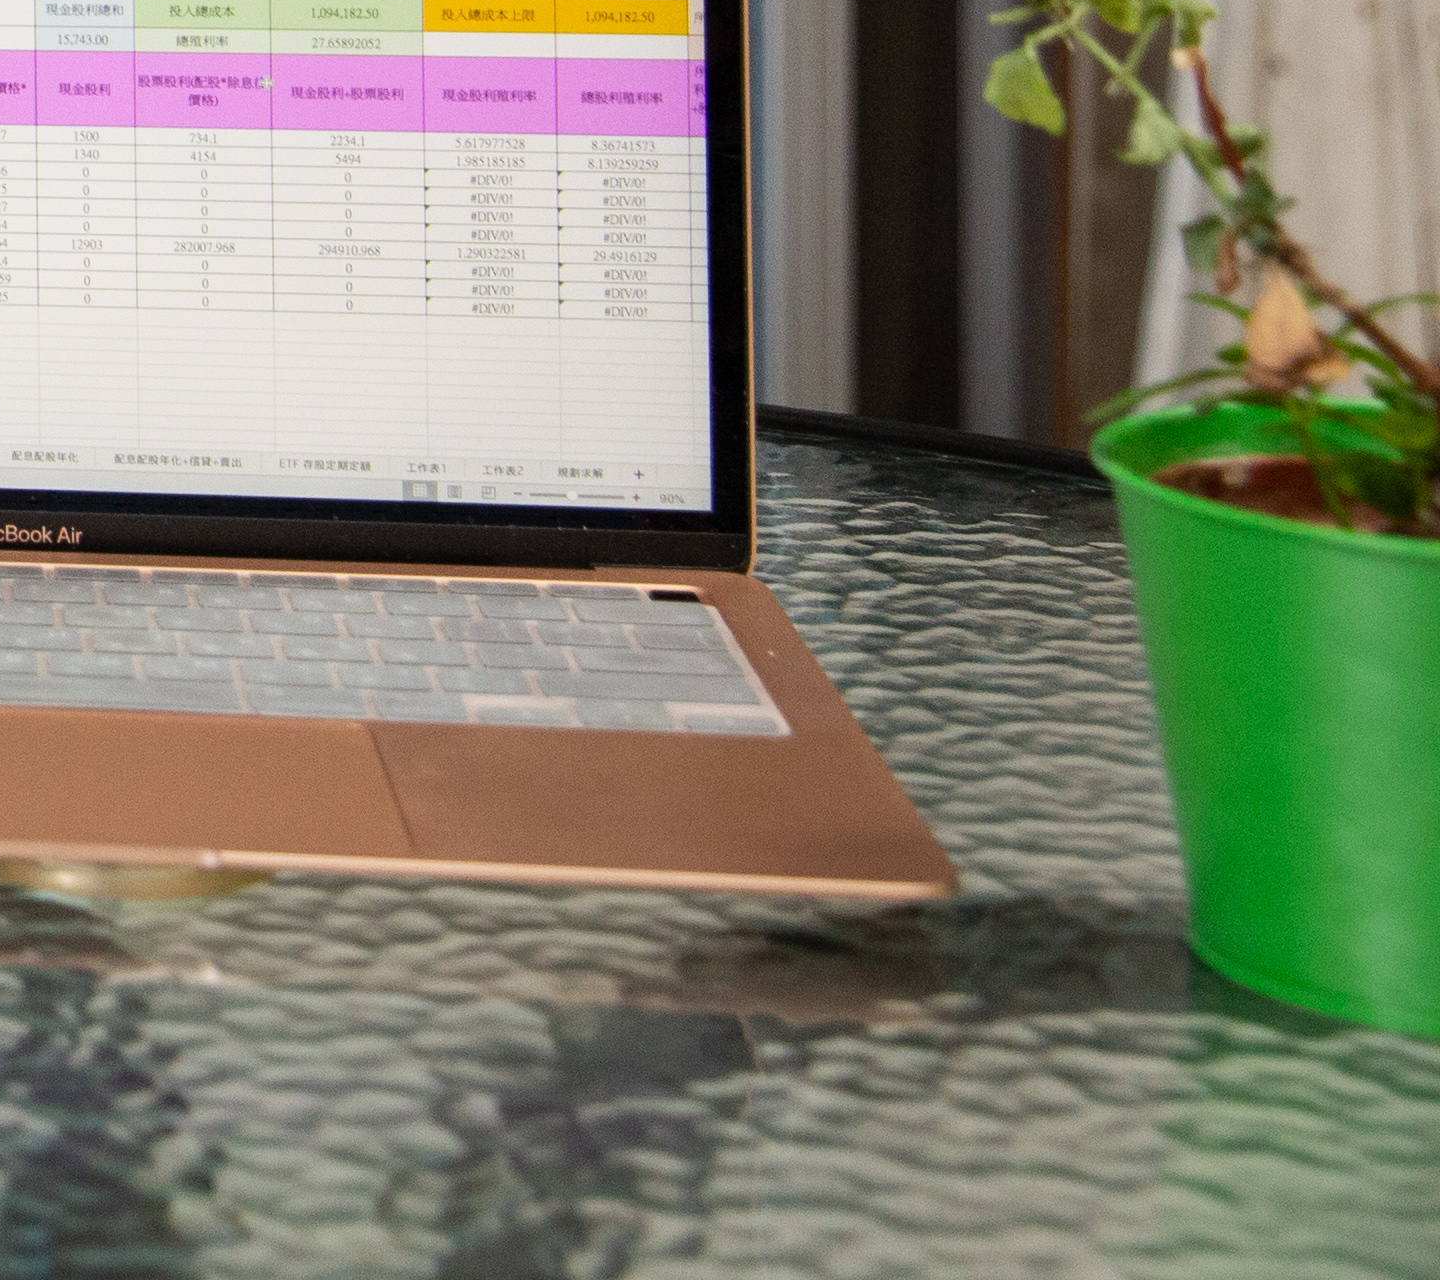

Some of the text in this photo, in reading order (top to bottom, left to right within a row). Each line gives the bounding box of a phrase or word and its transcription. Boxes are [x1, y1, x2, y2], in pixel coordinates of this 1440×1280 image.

[311, 7, 379, 20] 1,094,182.50
[585, 11, 655, 23] 1,094,182.50
[58, 34, 109, 46] 15,743.00
[312, 38, 381, 49] 27.65892052
[74, 130, 100, 143] 1500
[189, 132, 218, 145] 734.1
[330, 135, 366, 147] 2234.1
[74, 148, 101, 161] 1340
[189, 150, 217, 163] 4154
[335, 153, 362, 166] 5494
[602, 177, 646, 189] #DIV/0!
[602, 195, 647, 208] #DIV/0!
[602, 213, 647, 226] #DIV/0!
[71, 238, 103, 251] 12903
[279, 459, 299, 470] ETF
[659, 493, 685, 505] 90%
[57, 527, 82, 545] Air
